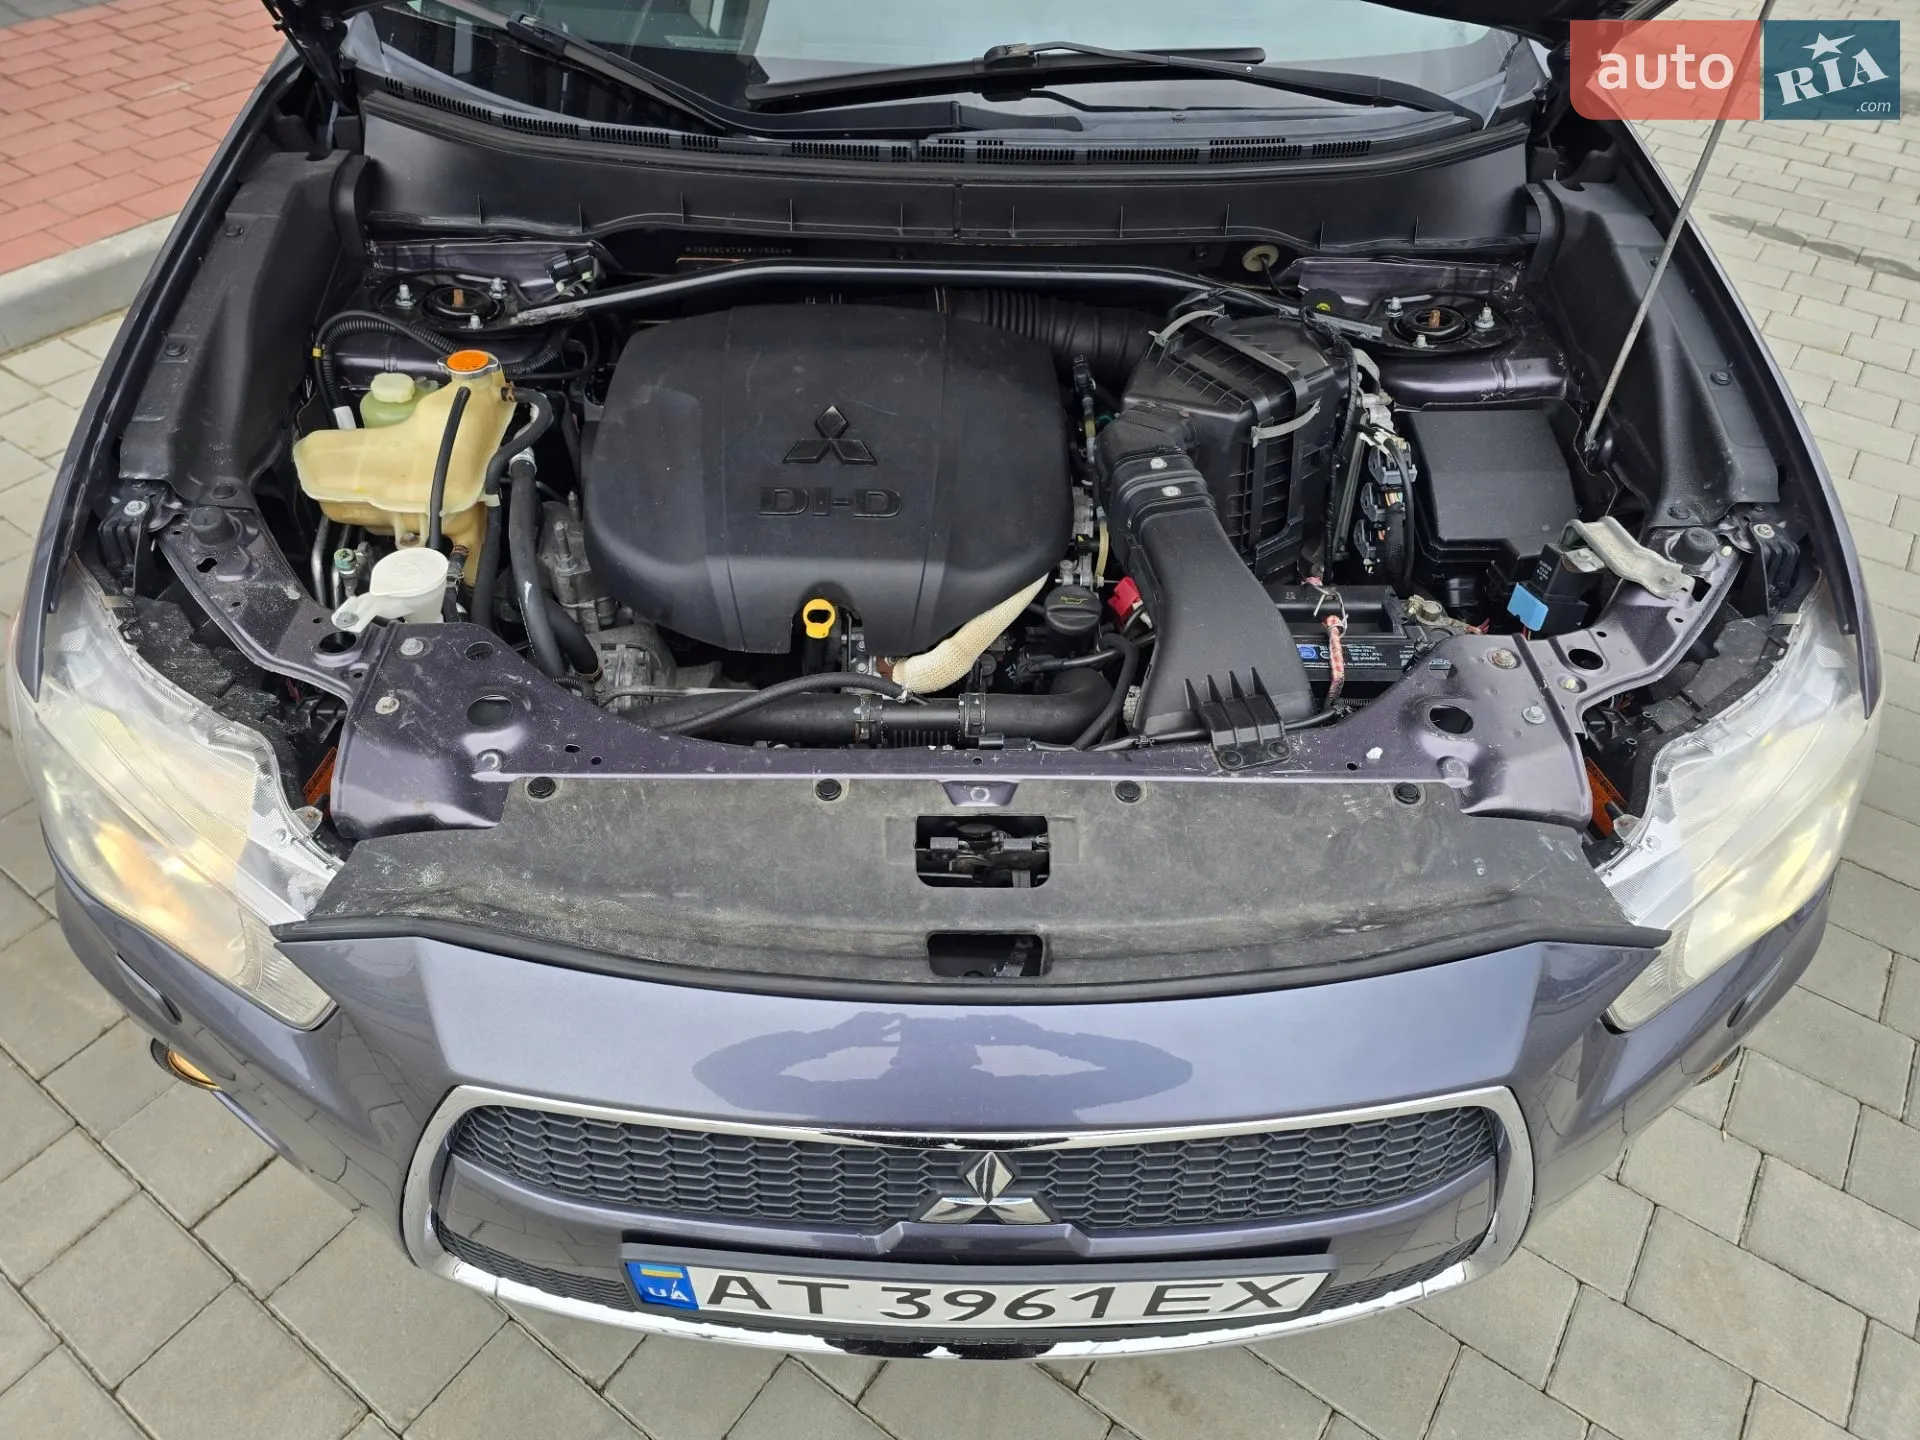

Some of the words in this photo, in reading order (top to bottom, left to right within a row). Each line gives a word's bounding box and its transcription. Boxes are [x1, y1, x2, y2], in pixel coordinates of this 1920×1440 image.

[759, 486, 902, 517] DI-D
[647, 1284, 690, 1302] UA
[707, 1274, 849, 1314] AT
[877, 1286, 1116, 1321] 3961
[1142, 1276, 1305, 1316] EX
